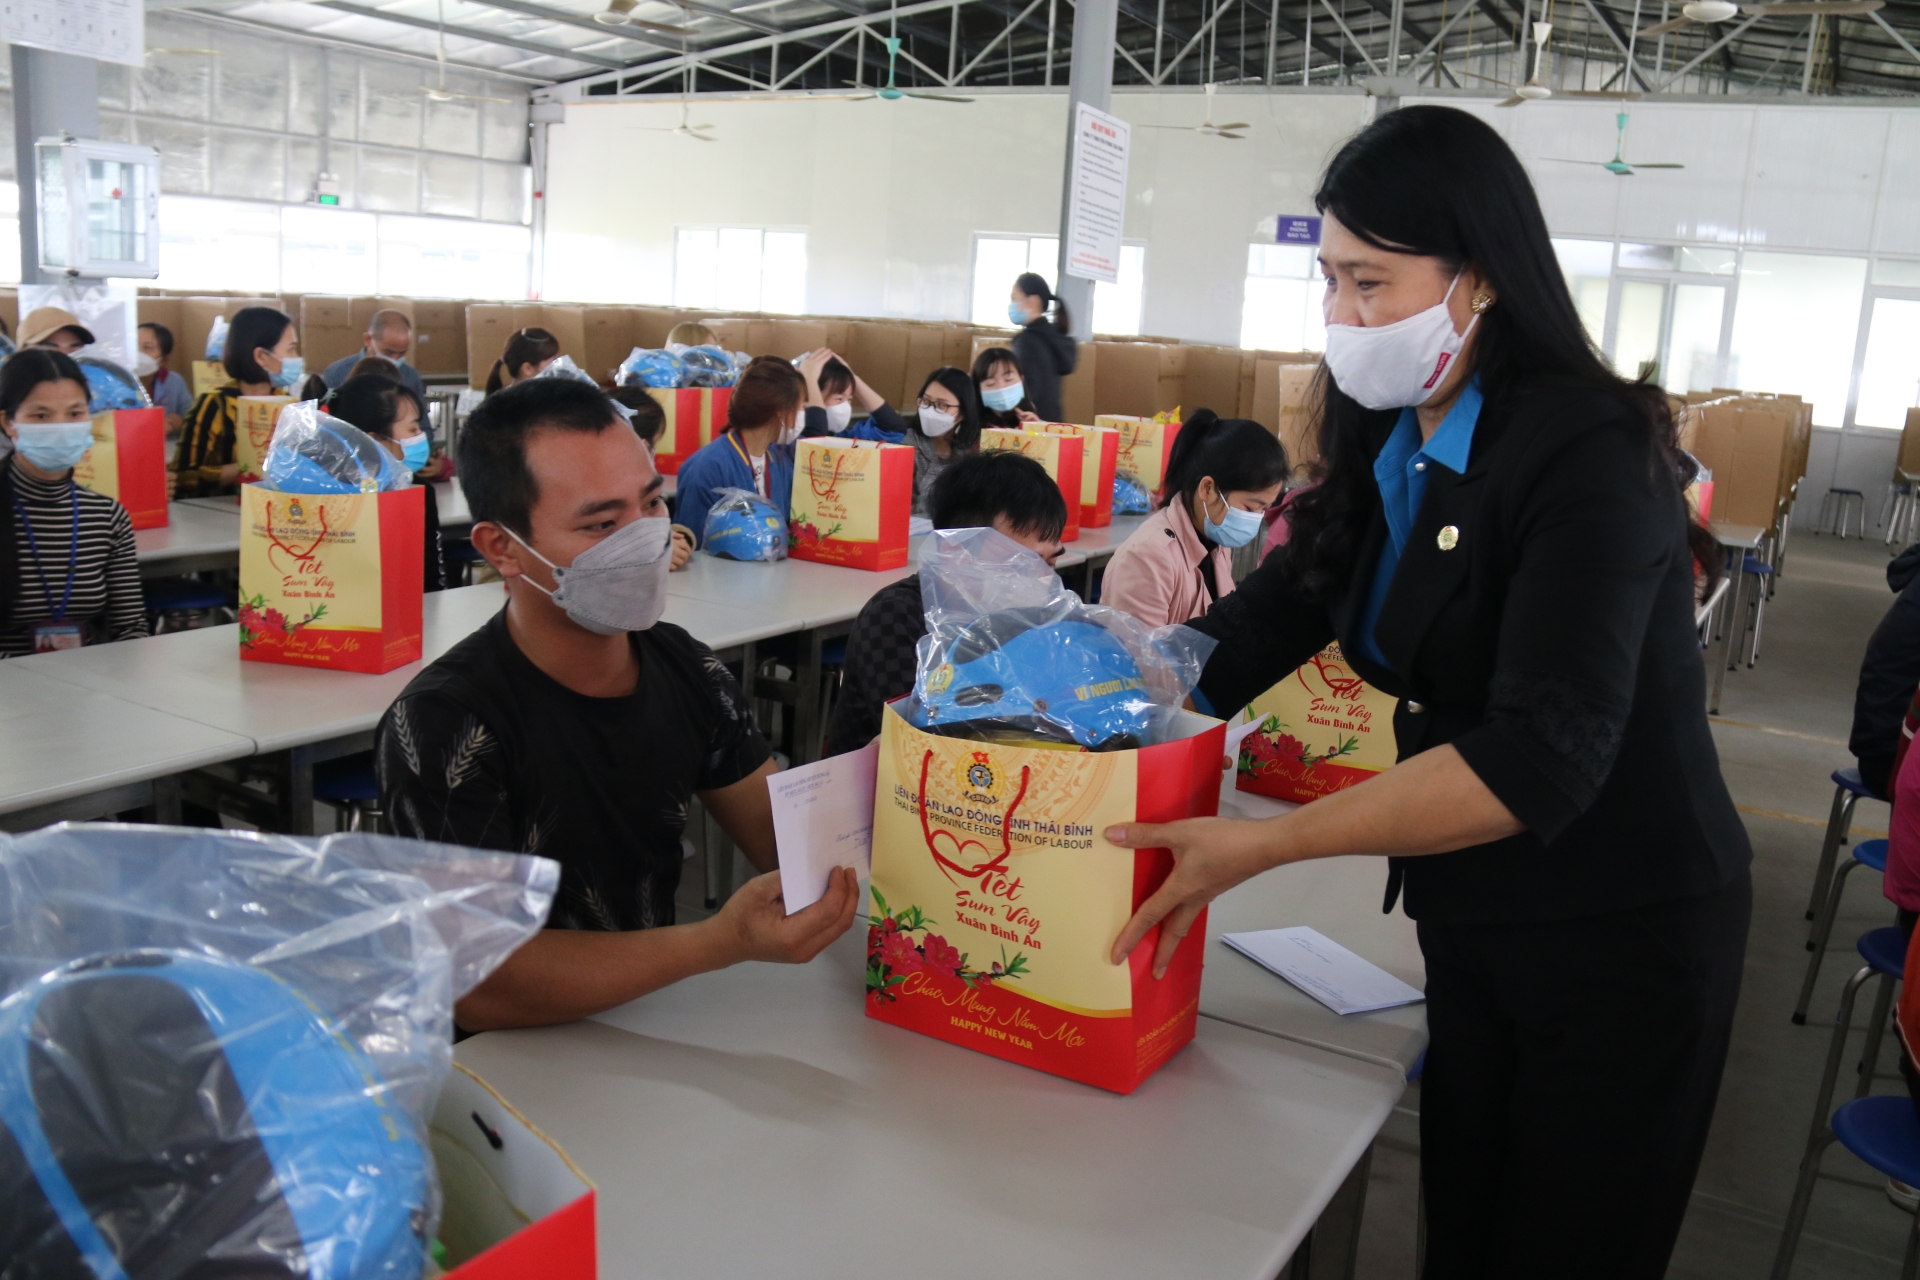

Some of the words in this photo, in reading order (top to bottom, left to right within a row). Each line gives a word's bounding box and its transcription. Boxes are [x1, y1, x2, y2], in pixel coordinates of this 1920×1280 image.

[1310, 697, 1340, 714] Sum
[1307, 713, 1330, 726] Xuân
[1357, 723, 1370, 733] An
[1294, 787, 1317, 798] HAPPY
[894, 784, 909, 800] LIÊN
[942, 804, 963, 817] LAO
[967, 809, 1002, 826] ĐỘNG
[1034, 820, 1060, 835] THÁI
[1064, 821, 1093, 836] BÌNH
[894, 797, 909, 812] THAI
[910, 805, 926, 818] BIN
[929, 812, 973, 832] PROVINCE
[974, 824, 1032, 844] FEDERTION
[1034, 835, 1048, 846] OF
[1050, 839, 1093, 850] LABOUR
[955, 890, 996, 917] Sum
[955, 910, 987, 931] Xuân
[1023, 934, 1042, 949] An
[951, 1015, 982, 1033] HAPPY
[984, 1026, 1006, 1041] NEW
[1008, 1033, 1034, 1050] YEAR
